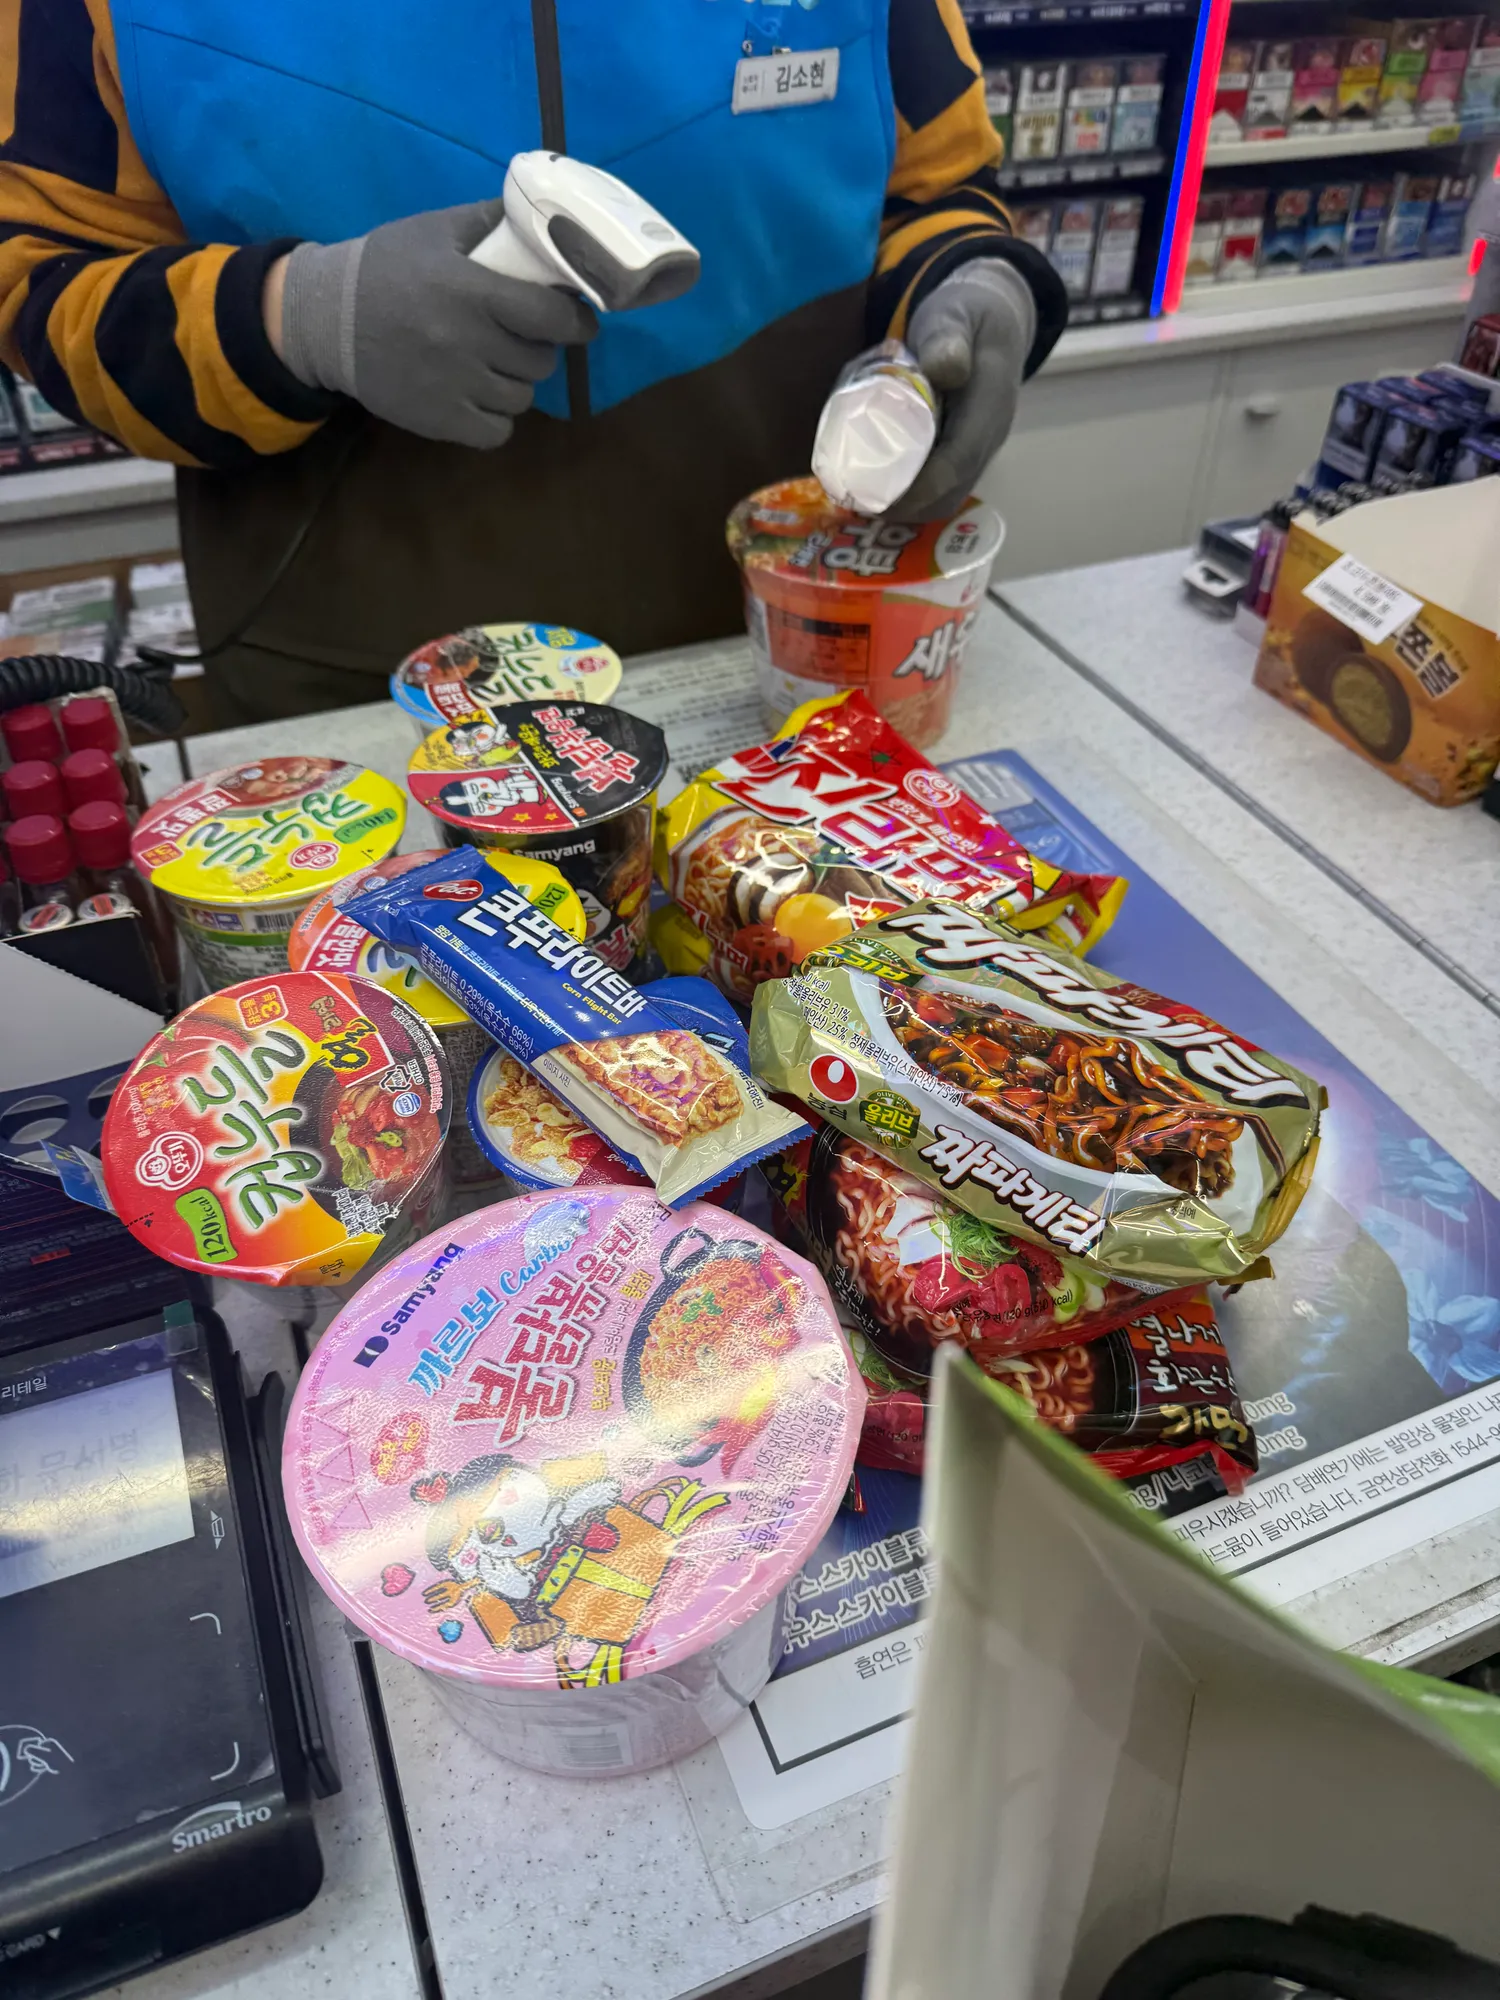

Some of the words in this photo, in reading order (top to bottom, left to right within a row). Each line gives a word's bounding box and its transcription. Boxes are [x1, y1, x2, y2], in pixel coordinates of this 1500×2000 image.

[775, 60, 826, 94] 김소현
[152, 792, 232, 839] 짬뽕맛
[186, 790, 371, 873] 컵누들
[313, 918, 368, 967] 콤한맛
[457, 888, 647, 1018] 콘푸라이트바
[580, 990, 605, 1014] Flight
[604, 1008, 623, 1025] Bar
[829, 1003, 851, 1023] 3.1%
[880, 899, 1311, 1111] 짜파게티
[407, 1058, 425, 1086] OTHER
[826, 1021, 850, 1045] 25%,
[850, 1032, 937, 1093] 정제올리브유(스페인산)
[183, 1030, 322, 1230] 컵누들
[861, 1101, 917, 1136] 올리브
[166, 1136, 190, 1173] 오뚜기
[918, 1122, 1108, 1259] 짜파게티
[191, 1196, 229, 1259] 120kcal
[386, 1241, 465, 1337] Samyang
[407, 1287, 503, 1397] 까르보
[498, 1234, 574, 1297] Carbo
[451, 1219, 640, 1449] 불닭볶음면
[2, 1376, 49, 1400] 리테일
[1174, 1483, 1295, 1543] 피우시겠습니까?
[1292, 1443, 1388, 1495] 담배연기에는
[1383, 1421, 1437, 1457] 발암성
[1431, 1401, 1481, 1434] 물질인
[1261, 1488, 1363, 1542] 들어있습니다.
[1357, 1447, 1452, 1499] 금연상담전화
[1449, 1424, 1500, 1457] 1544-9
[853, 1640, 913, 1680] 흡연은
[171, 1804, 273, 1854] Smartro
